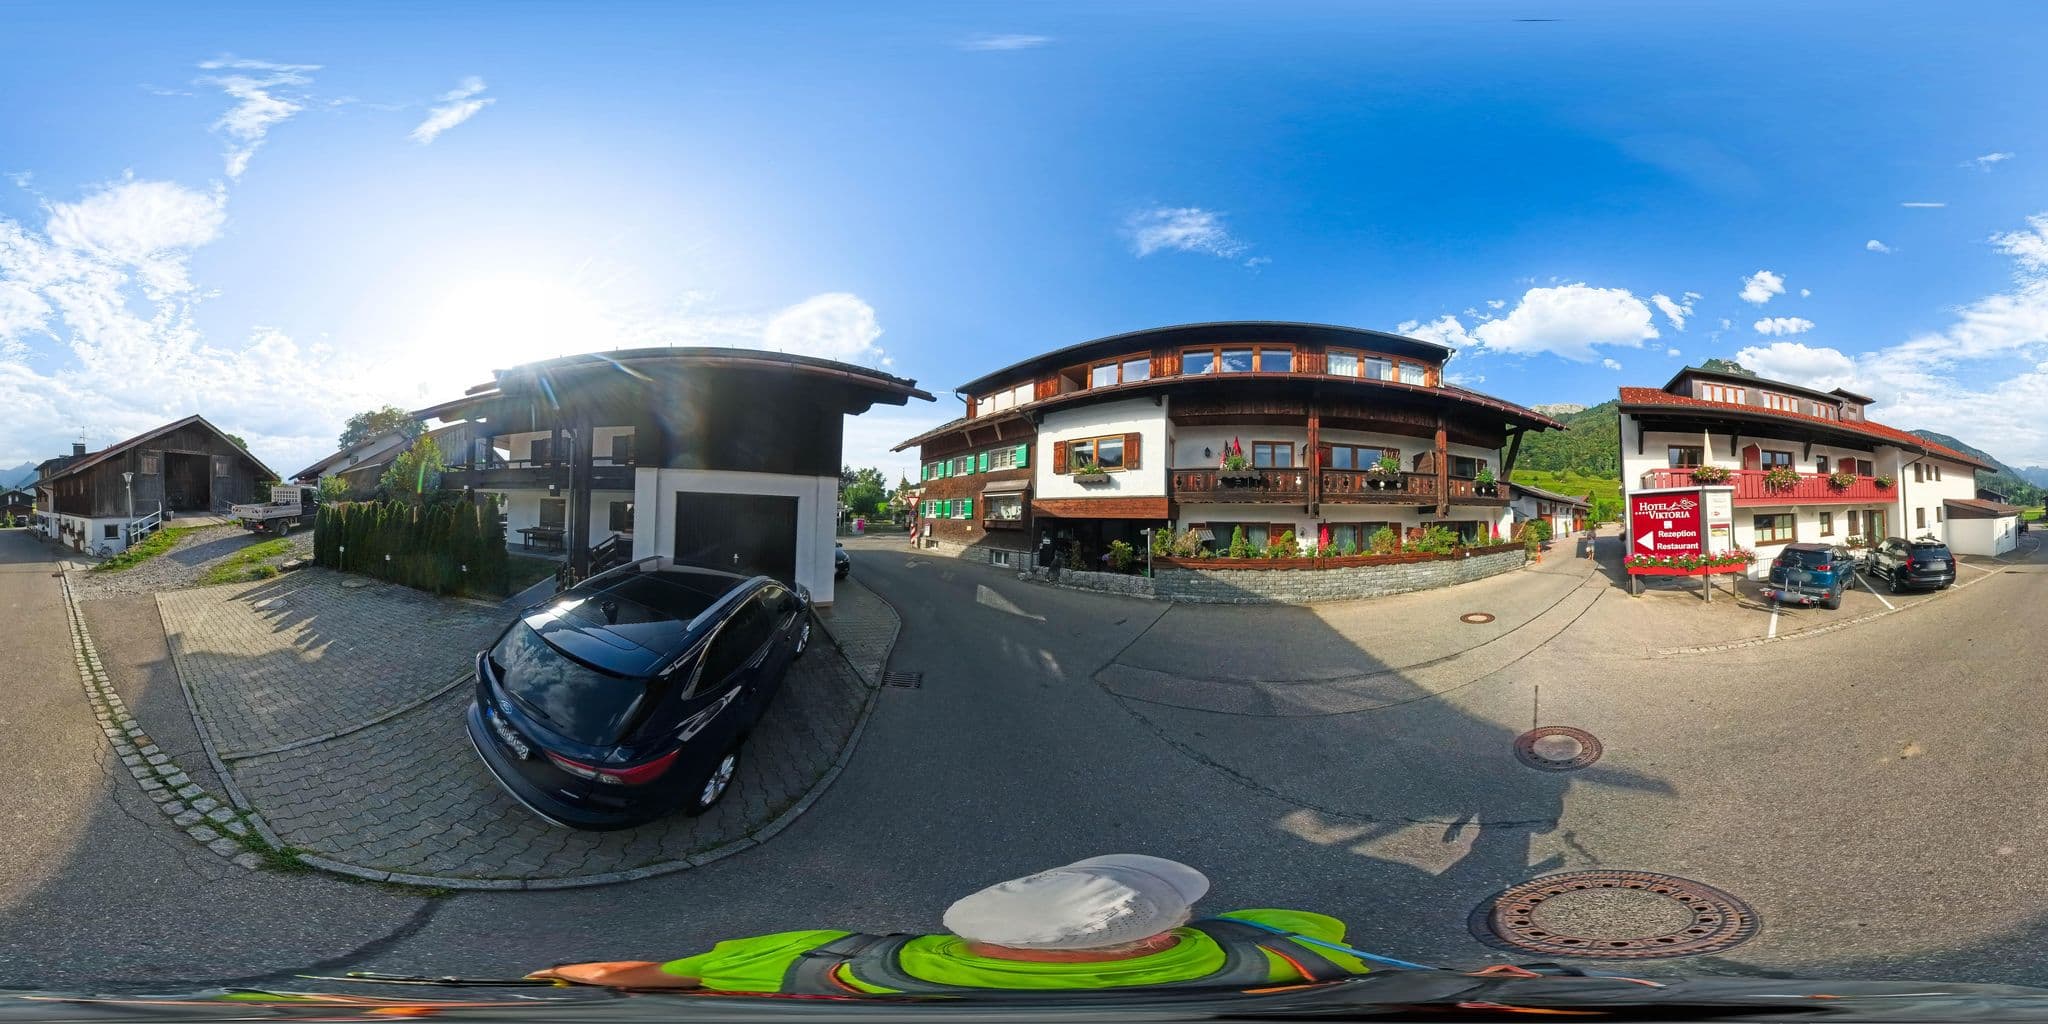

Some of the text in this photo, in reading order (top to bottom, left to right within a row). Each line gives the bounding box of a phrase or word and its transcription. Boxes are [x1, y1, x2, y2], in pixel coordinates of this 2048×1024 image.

[1639, 502, 1667, 511] HOTEL
[1648, 511, 1690, 519] VIKTORIA
[1658, 530, 1697, 538] Rezeption
